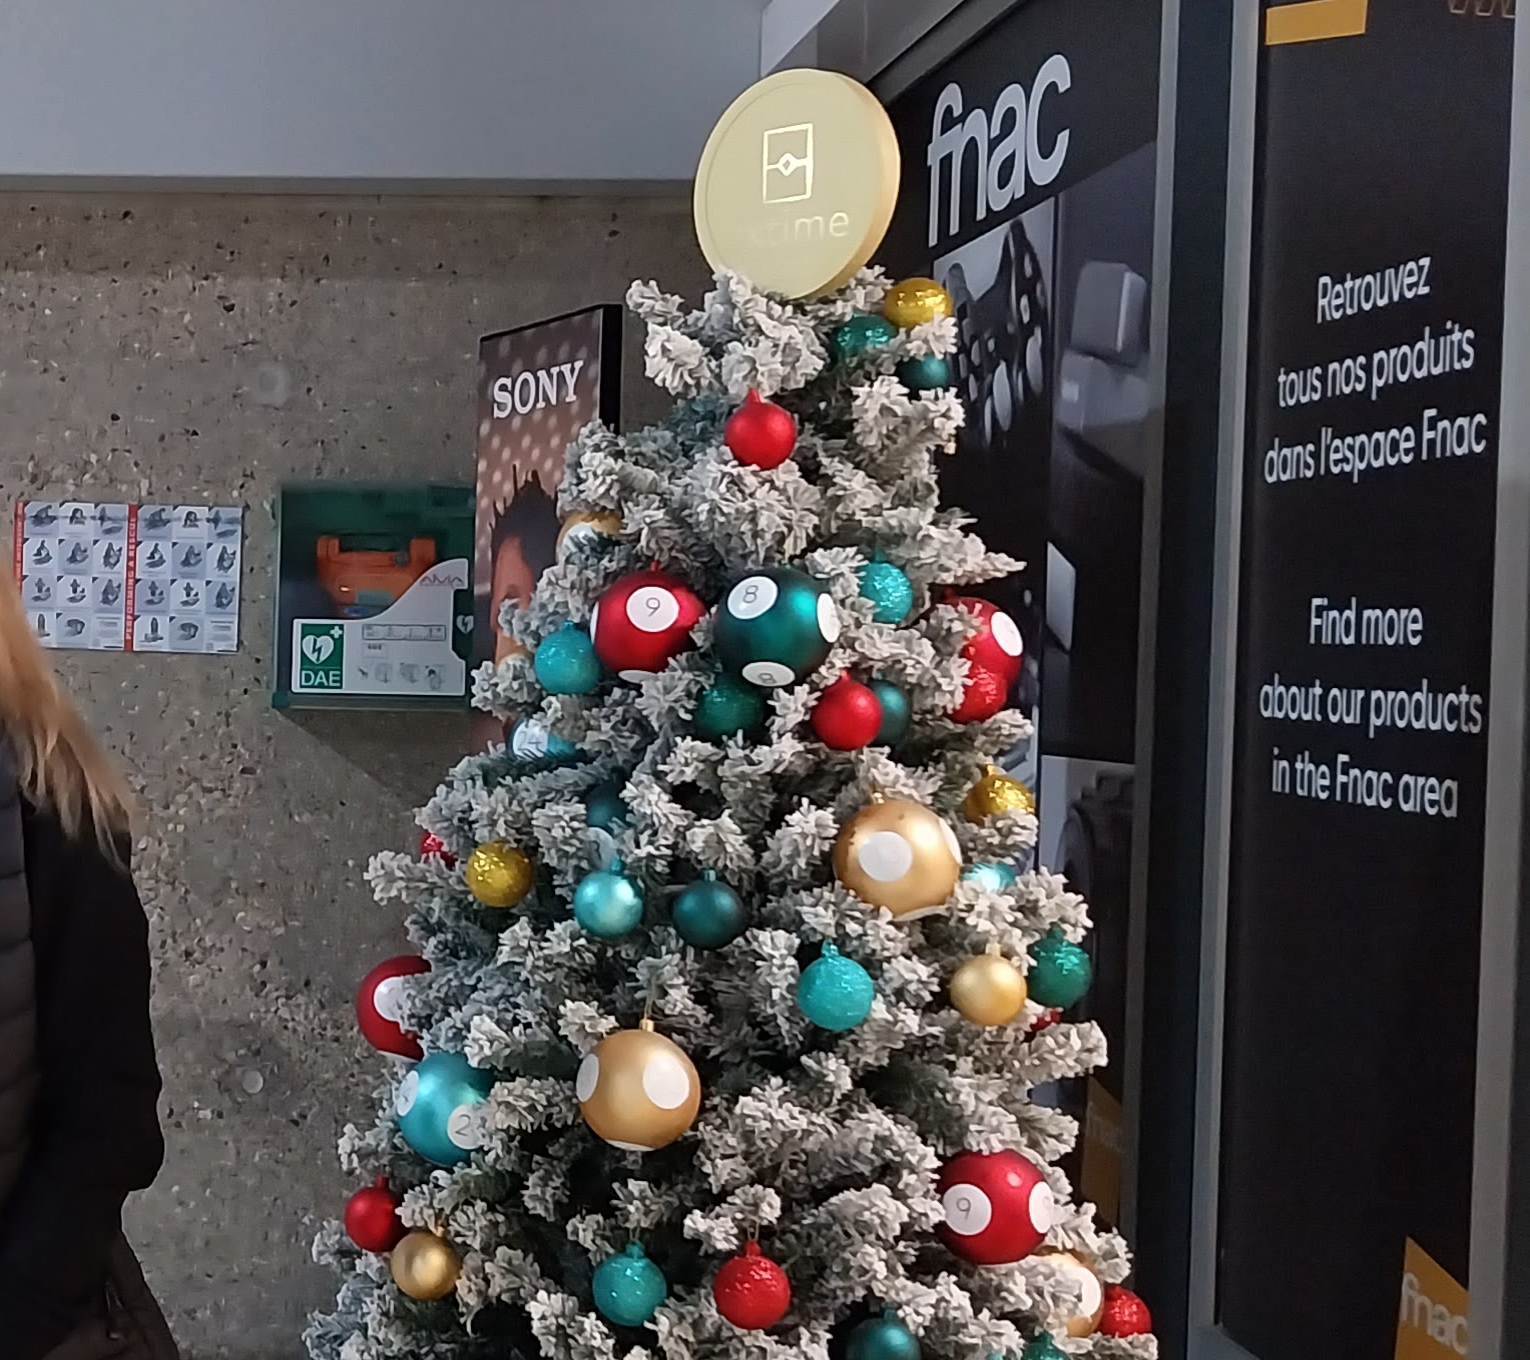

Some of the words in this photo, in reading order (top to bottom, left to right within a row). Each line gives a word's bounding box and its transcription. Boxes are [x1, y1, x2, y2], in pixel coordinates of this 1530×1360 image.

[927, 53, 1072, 248] fnac
[1317, 256, 1432, 324] Retrouvez
[492, 359, 584, 419] SONY
[1277, 367, 1322, 408] tous
[1327, 355, 1367, 398] nos
[1371, 320, 1475, 401] produits
[1264, 437, 1316, 484] dans
[1320, 426, 1416, 484] l'espace
[1421, 408, 1488, 461] Fnac
[128, 517, 137, 557] RESCUE
[645, 597, 661, 617] 9
[742, 584, 759, 604] 8
[1309, 596, 1357, 645] Find
[1361, 607, 1424, 646] more
[301, 670, 342, 687] DAE
[1259, 672, 1323, 721] about
[1327, 687, 1366, 724] our
[1368, 678, 1483, 739] products
[1272, 746, 1290, 794] in
[1294, 750, 1331, 800] the
[1335, 753, 1394, 809] Fnac
[1398, 773, 1459, 818] area
[956, 1197, 972, 1221] 9
[1400, 1271, 1469, 1356] fnac
